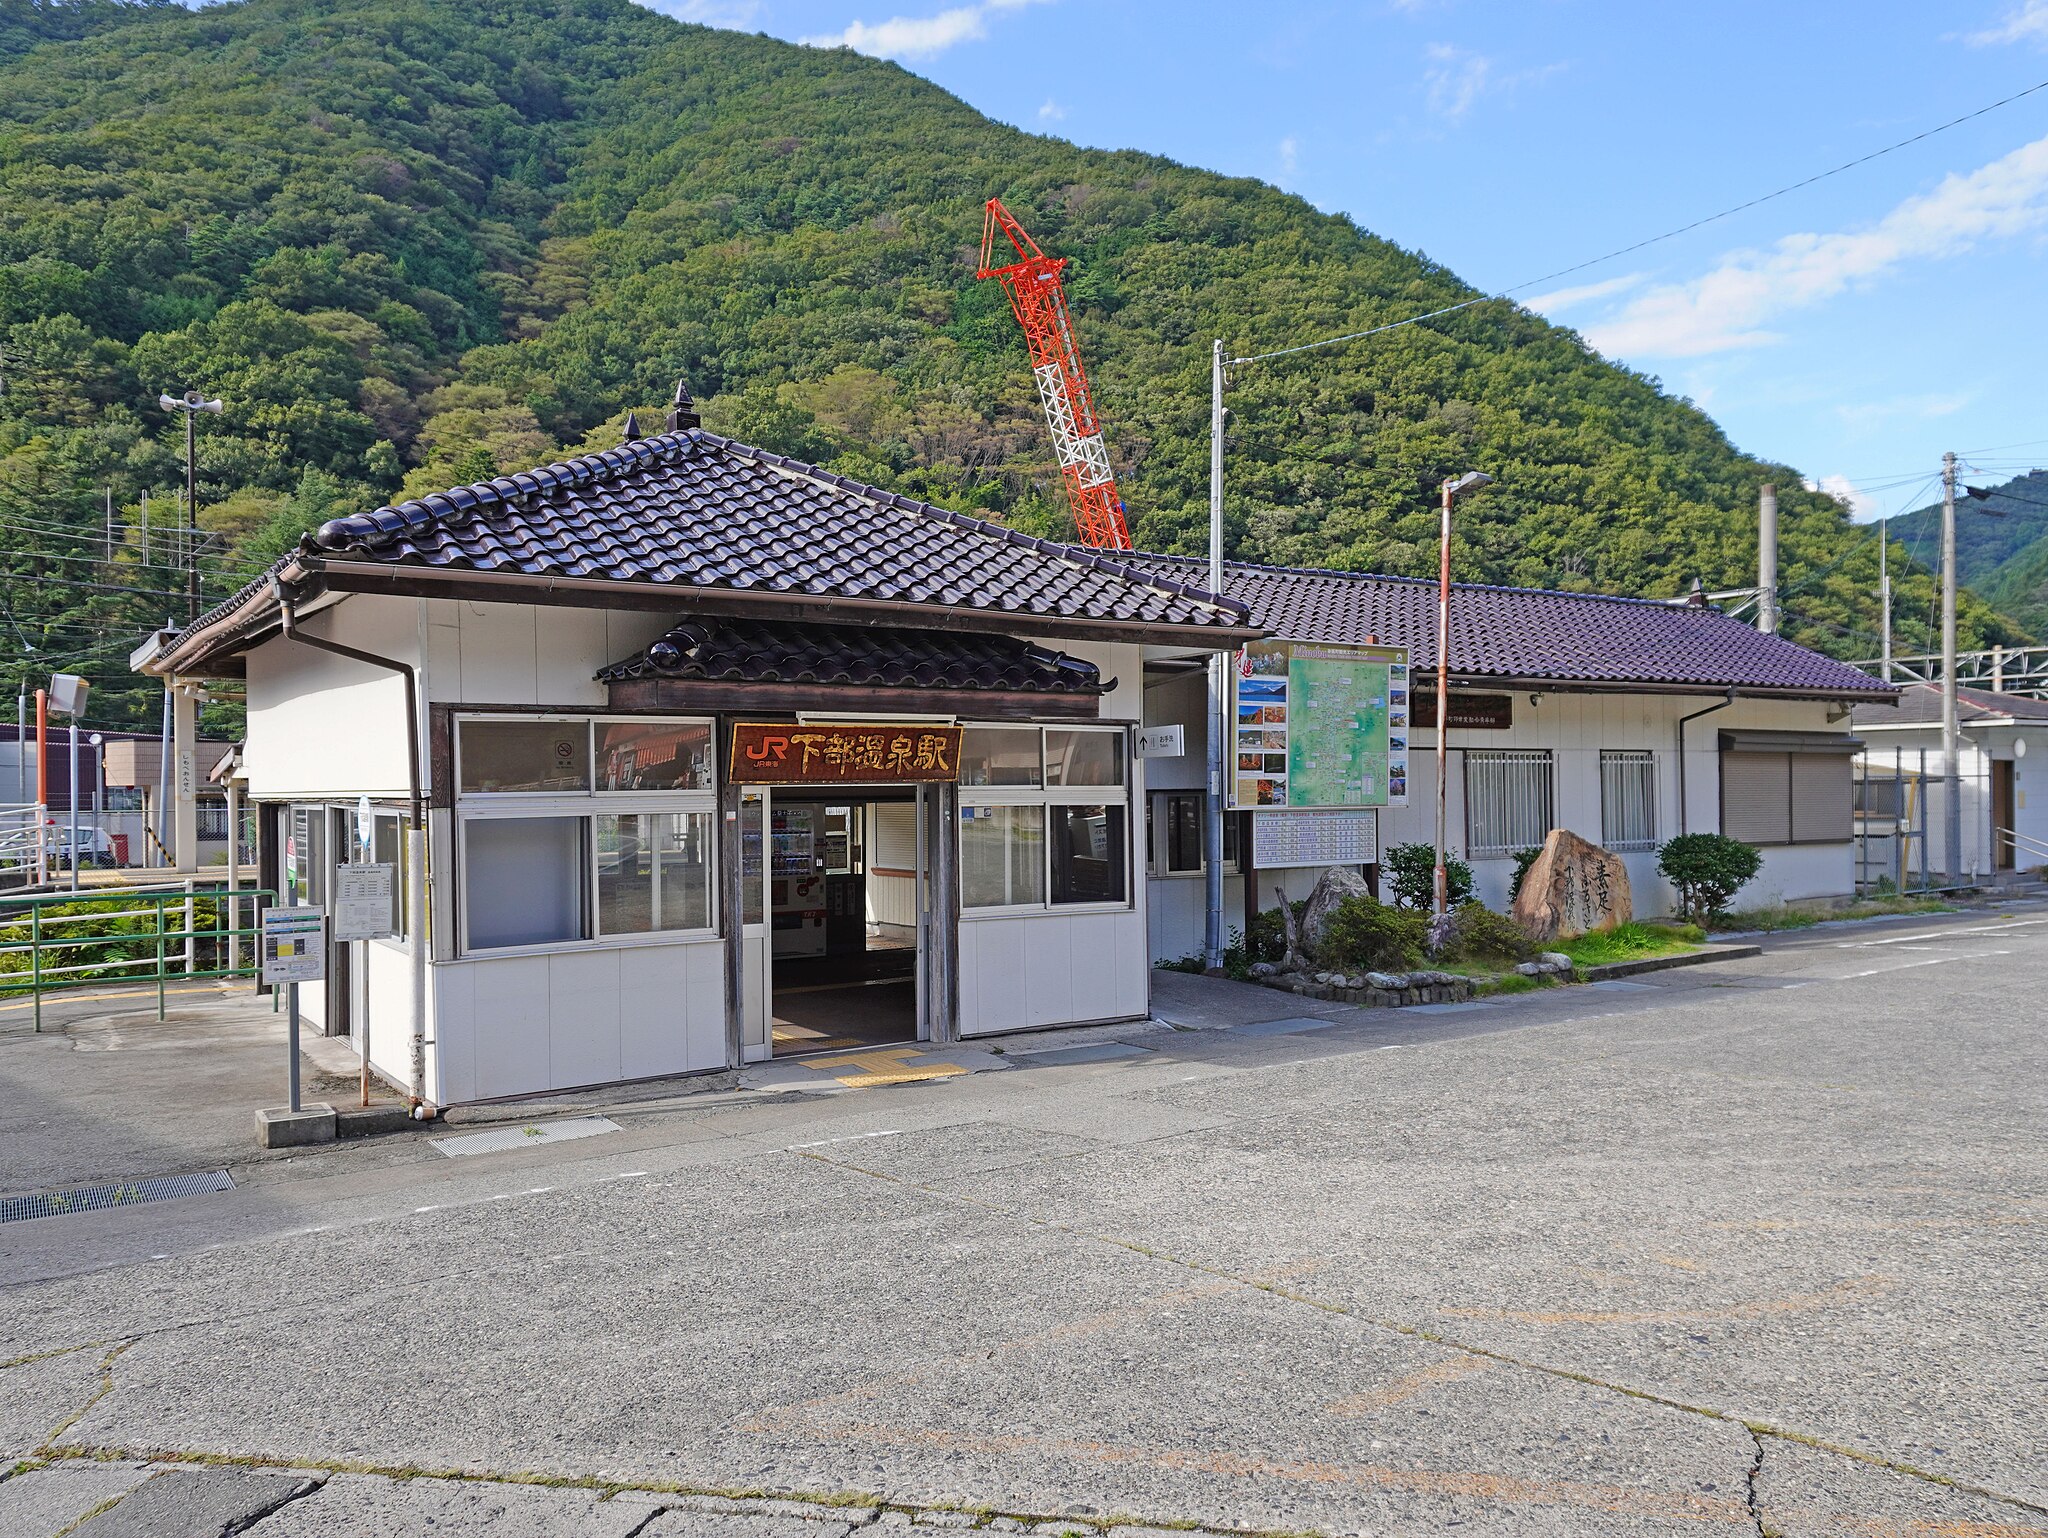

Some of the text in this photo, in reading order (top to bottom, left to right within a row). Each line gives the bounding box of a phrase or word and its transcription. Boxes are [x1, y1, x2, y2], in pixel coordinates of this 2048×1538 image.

[1294, 645, 1326, 658] Minobu
[746, 736, 788, 760] JR
[790, 733, 949, 775] 下部温泉駅
